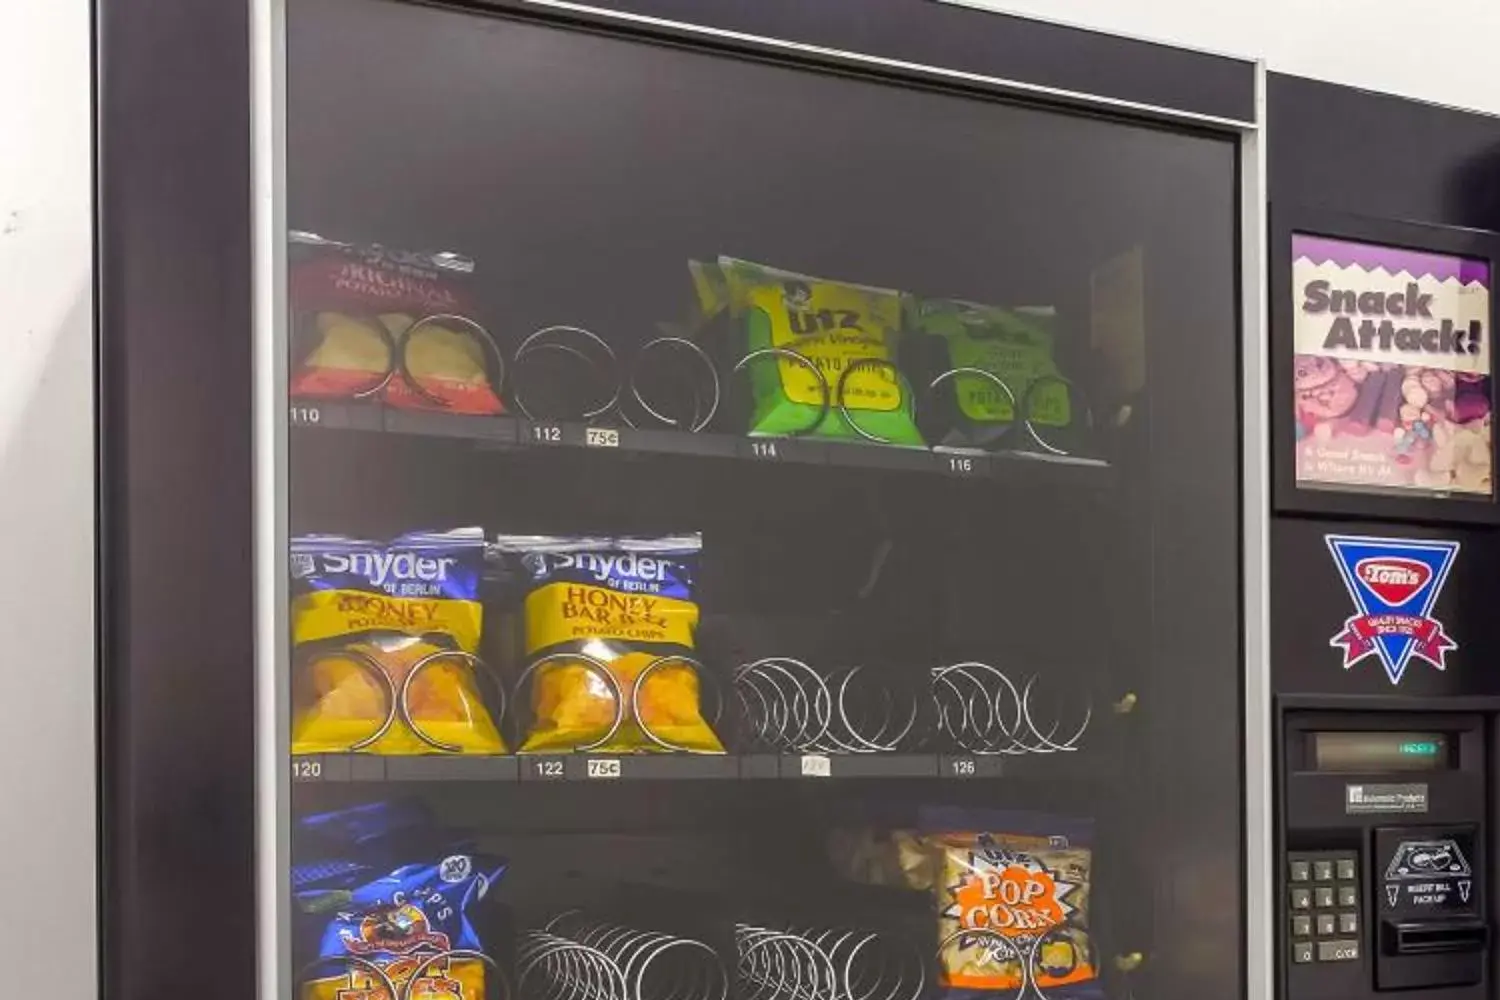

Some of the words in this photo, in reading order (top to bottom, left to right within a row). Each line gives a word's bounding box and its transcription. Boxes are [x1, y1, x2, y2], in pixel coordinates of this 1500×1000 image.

[1302, 280, 1433, 318] Snack
[1323, 317, 1482, 355] Attack!
[291, 408, 319, 423] 110
[534, 426, 561, 441] 112
[752, 443, 776, 458] 114
[949, 458, 972, 472] 116
[323, 552, 455, 585] Snyder
[553, 553, 672, 581] Snyder
[1365, 563, 1421, 585] Tom's
[567, 586, 657, 616] HONEY
[292, 763, 321, 777] 120
[536, 761, 564, 775] 122
[952, 760, 976, 775] 126
[979, 870, 1046, 906] POP
[966, 904, 1053, 930] CORN
